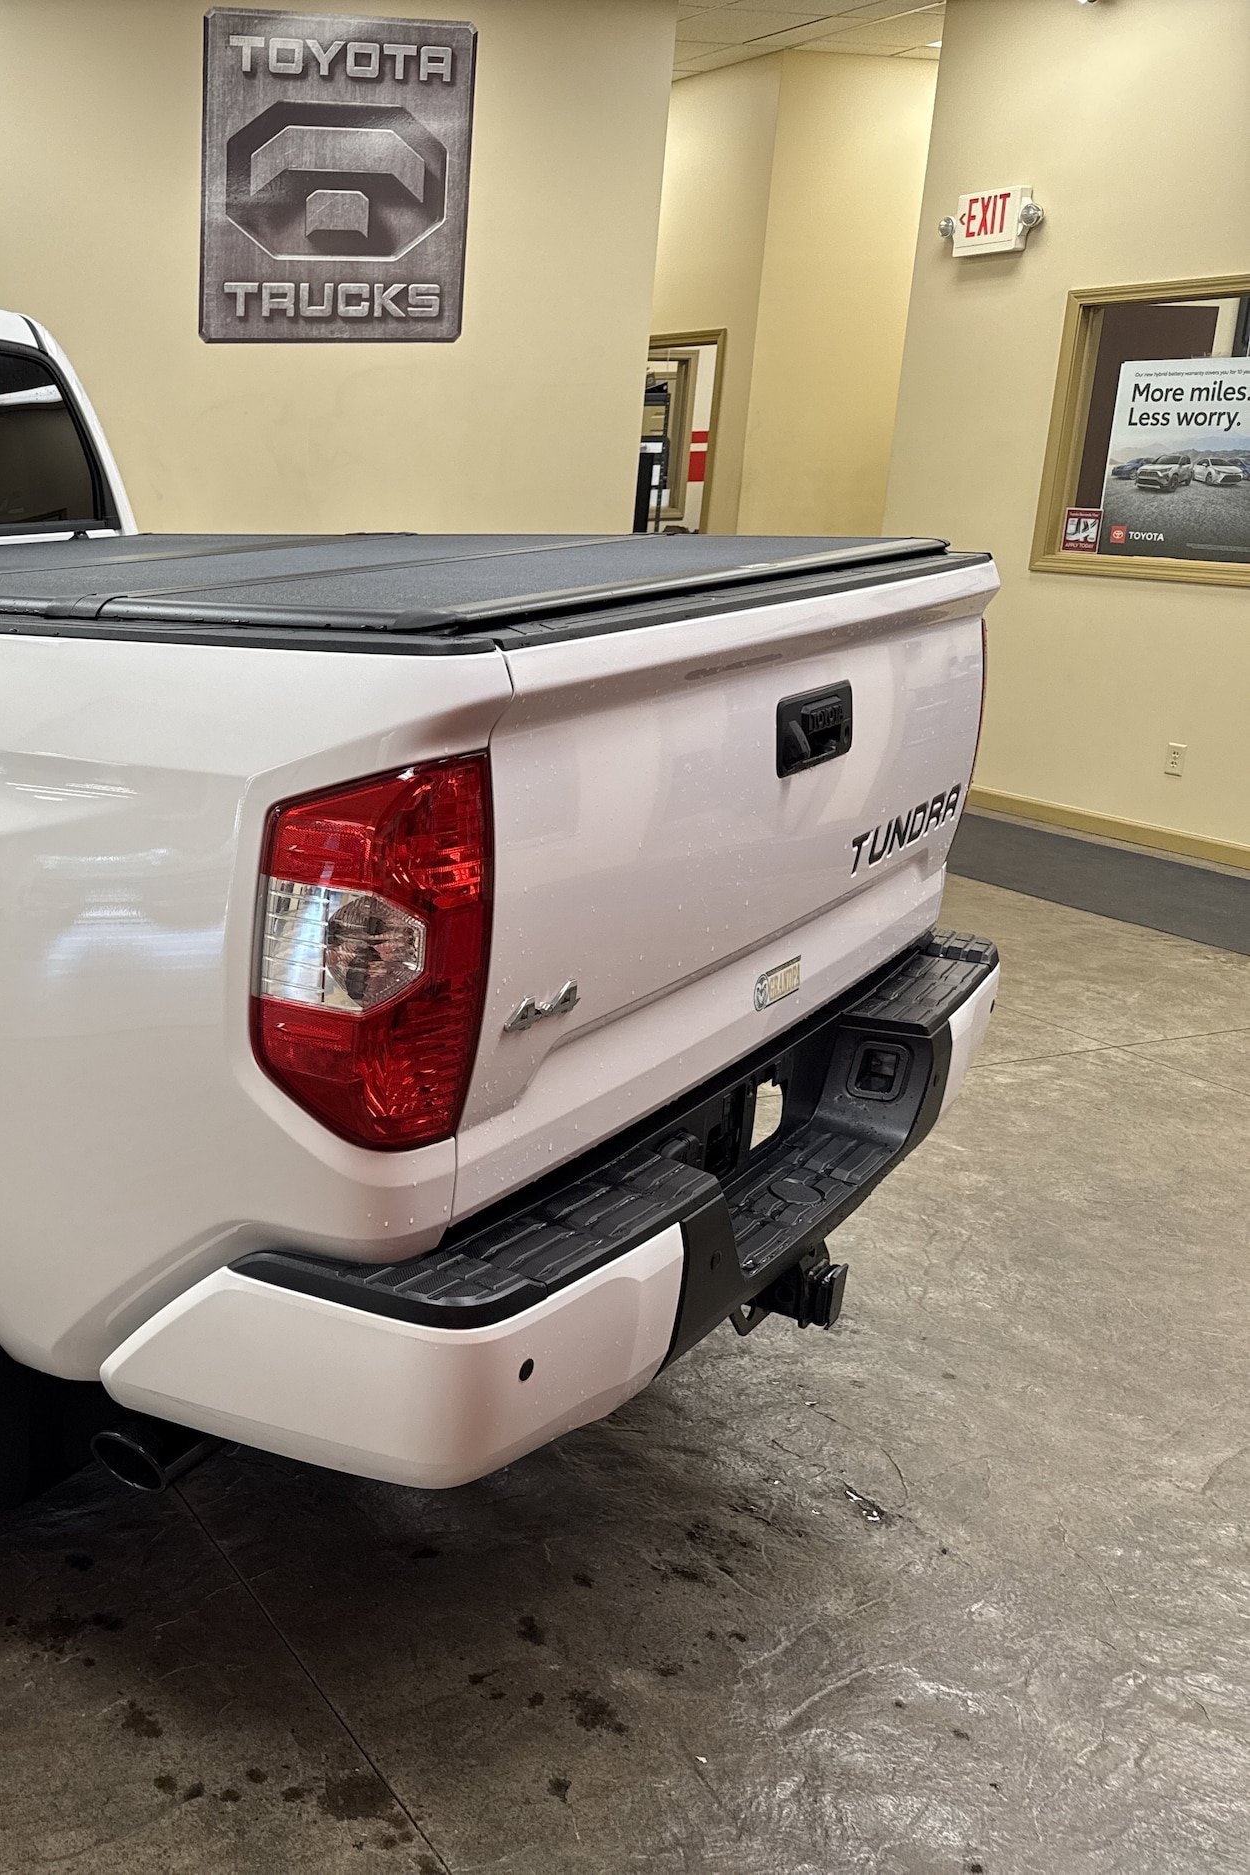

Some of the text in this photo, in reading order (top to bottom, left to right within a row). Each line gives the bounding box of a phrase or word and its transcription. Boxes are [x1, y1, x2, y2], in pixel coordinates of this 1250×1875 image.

[229, 36, 452, 82] TOYOTA
[965, 193, 1011, 238] EXIT
[223, 282, 441, 318] TRUCKS
[1132, 380, 1250, 402] More miles.
[1128, 407, 1241, 432] Less worry.
[1129, 531, 1165, 541] TOYOTA
[851, 783, 961, 877] TUNDRA
